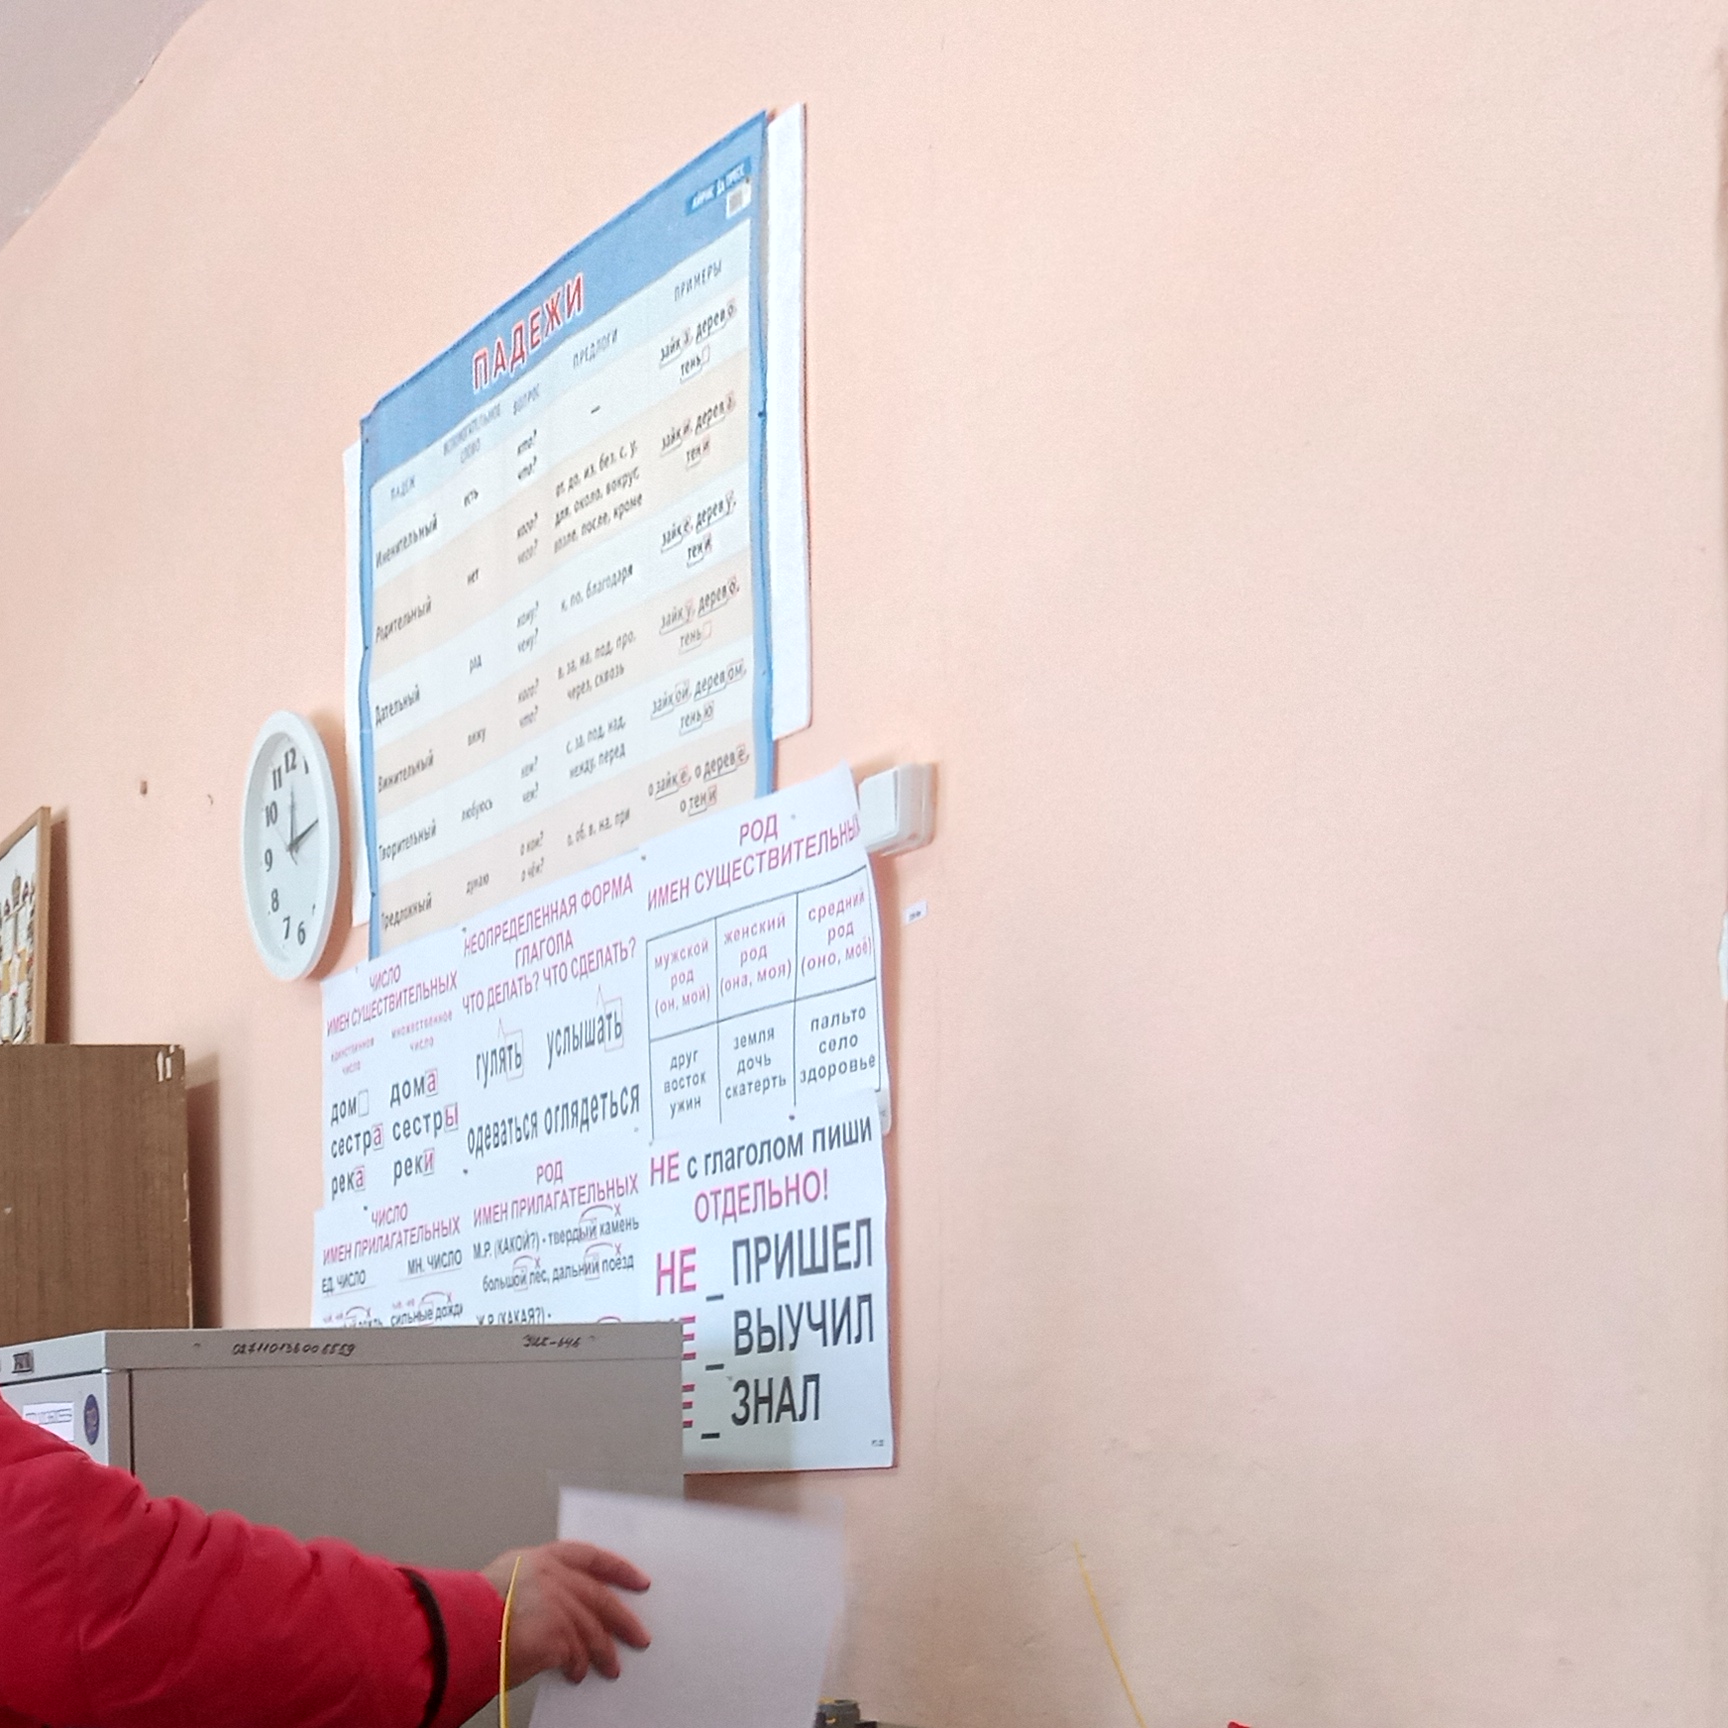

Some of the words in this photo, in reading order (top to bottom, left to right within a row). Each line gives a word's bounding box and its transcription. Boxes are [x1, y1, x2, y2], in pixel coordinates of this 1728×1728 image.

[674, 260, 722, 302] ПРИМЕРЫ
[473, 274, 583, 392] ПАДЕЖИ
[573, 328, 618, 369] ПРЕДЛОГИ
[376, 512, 438, 569] Именительный
[586, 564, 633, 599] благодаря
[376, 595, 432, 643] Родительный
[680, 626, 702, 648] тень
[594, 663, 625, 688] сквозь
[375, 684, 420, 728] Дательный
[680, 703, 714, 730] тенью
[284, 747, 297, 773] 12
[378, 749, 434, 794] Винительный
[599, 743, 626, 767] перед
[656, 770, 691, 795] зайке,
[695, 764, 702, 779] о
[703, 747, 750, 781] дереве,
[272, 766, 283, 791] 11
[265, 801, 278, 827] 10
[680, 799, 686, 812] о
[689, 786, 718, 809] тени
[379, 817, 437, 862] Творительный
[739, 813, 778, 846] РОД
[264, 848, 273, 872] 9
[271, 888, 279, 912] 8
[648, 877, 690, 911] ИМЕН
[808, 889, 865, 923] средний
[282, 916, 291, 940] 7
[464, 894, 577, 957] НЕОПРЕДЕЛЕННАЯ
[581, 872, 633, 910] ФОРМА
[723, 912, 786, 946] женский
[297, 921, 306, 945] 6
[515, 929, 574, 969] ГЛАГОЛА
[827, 920, 854, 946] род
[654, 937, 709, 971] мужской
[740, 944, 767, 967] род
[801, 951, 841, 977] (оно,
[369, 964, 401, 991] ЧИСЛО
[462, 990, 484, 1015] ЧТО
[487, 971, 539, 1011] ДЕЛАТЬ?
[543, 962, 568, 987] ЧТО
[570, 936, 636, 981] СДЕЛАТЬ?
[670, 969, 695, 990] род
[720, 974, 752, 997] (она,
[757, 959, 792, 983] моя)
[327, 1011, 349, 1037] ИМЕН
[351, 970, 458, 1027] СУЩЕСТВИТЕЛЬНЫХ
[654, 997, 678, 1018] (он,
[682, 984, 711, 1008] мой)
[810, 1006, 866, 1033] пальто
[476, 1042, 523, 1089] гулять
[547, 1011, 622, 1070] услышать
[733, 1027, 775, 1051] земля
[819, 1033, 859, 1055] село
[670, 1049, 698, 1071] друг
[737, 1053, 772, 1076] дочь
[800, 1053, 877, 1084] здоровье
[390, 1073, 436, 1108] дома
[664, 1070, 707, 1094] восток
[725, 1073, 787, 1100] скатерть
[331, 1097, 357, 1126] дом
[392, 1102, 459, 1141] сестры
[467, 1110, 538, 1159] одеваться
[544, 1084, 640, 1135] оглядеться
[670, 1095, 702, 1120] ужин
[331, 1127, 382, 1158] сестра
[650, 1152, 680, 1187] НЕ
[687, 1156, 697, 1180] с
[704, 1131, 804, 1177] глаголом
[812, 1116, 872, 1153] пиши
[331, 1169, 364, 1201] река
[393, 1152, 434, 1187] реки
[537, 1161, 563, 1185] РОД
[473, 1203, 508, 1228] ИМЕН
[511, 1173, 639, 1220] ПРИЛАГАТЕЛЬНЫХ
[694, 1167, 829, 1225] ОТДЕЛЬНО!
[371, 1203, 408, 1228] ЧИСЛО
[323, 1244, 352, 1266] ИМЕН
[354, 1216, 461, 1258] ПРИЛАГАТЕЛЬНЫХ
[494, 1229, 540, 1259] (КАКОЙ?)
[599, 1217, 640, 1237] камень
[407, 1258, 425, 1275] МН.
[427, 1249, 463, 1270] ЧИСЛО
[482, 1268, 526, 1292] большой
[529, 1268, 550, 1285] лес,
[602, 1254, 634, 1272] поезд
[656, 1246, 697, 1297] НЕ
[732, 1217, 873, 1286] ПРИШЕЛ
[336, 1269, 366, 1289] ЧИСЛО
[390, 1308, 434, 1327] сильные
[734, 1293, 874, 1357] ВЫУЧИЛ
[731, 1373, 820, 1426] ЗНАЛ
